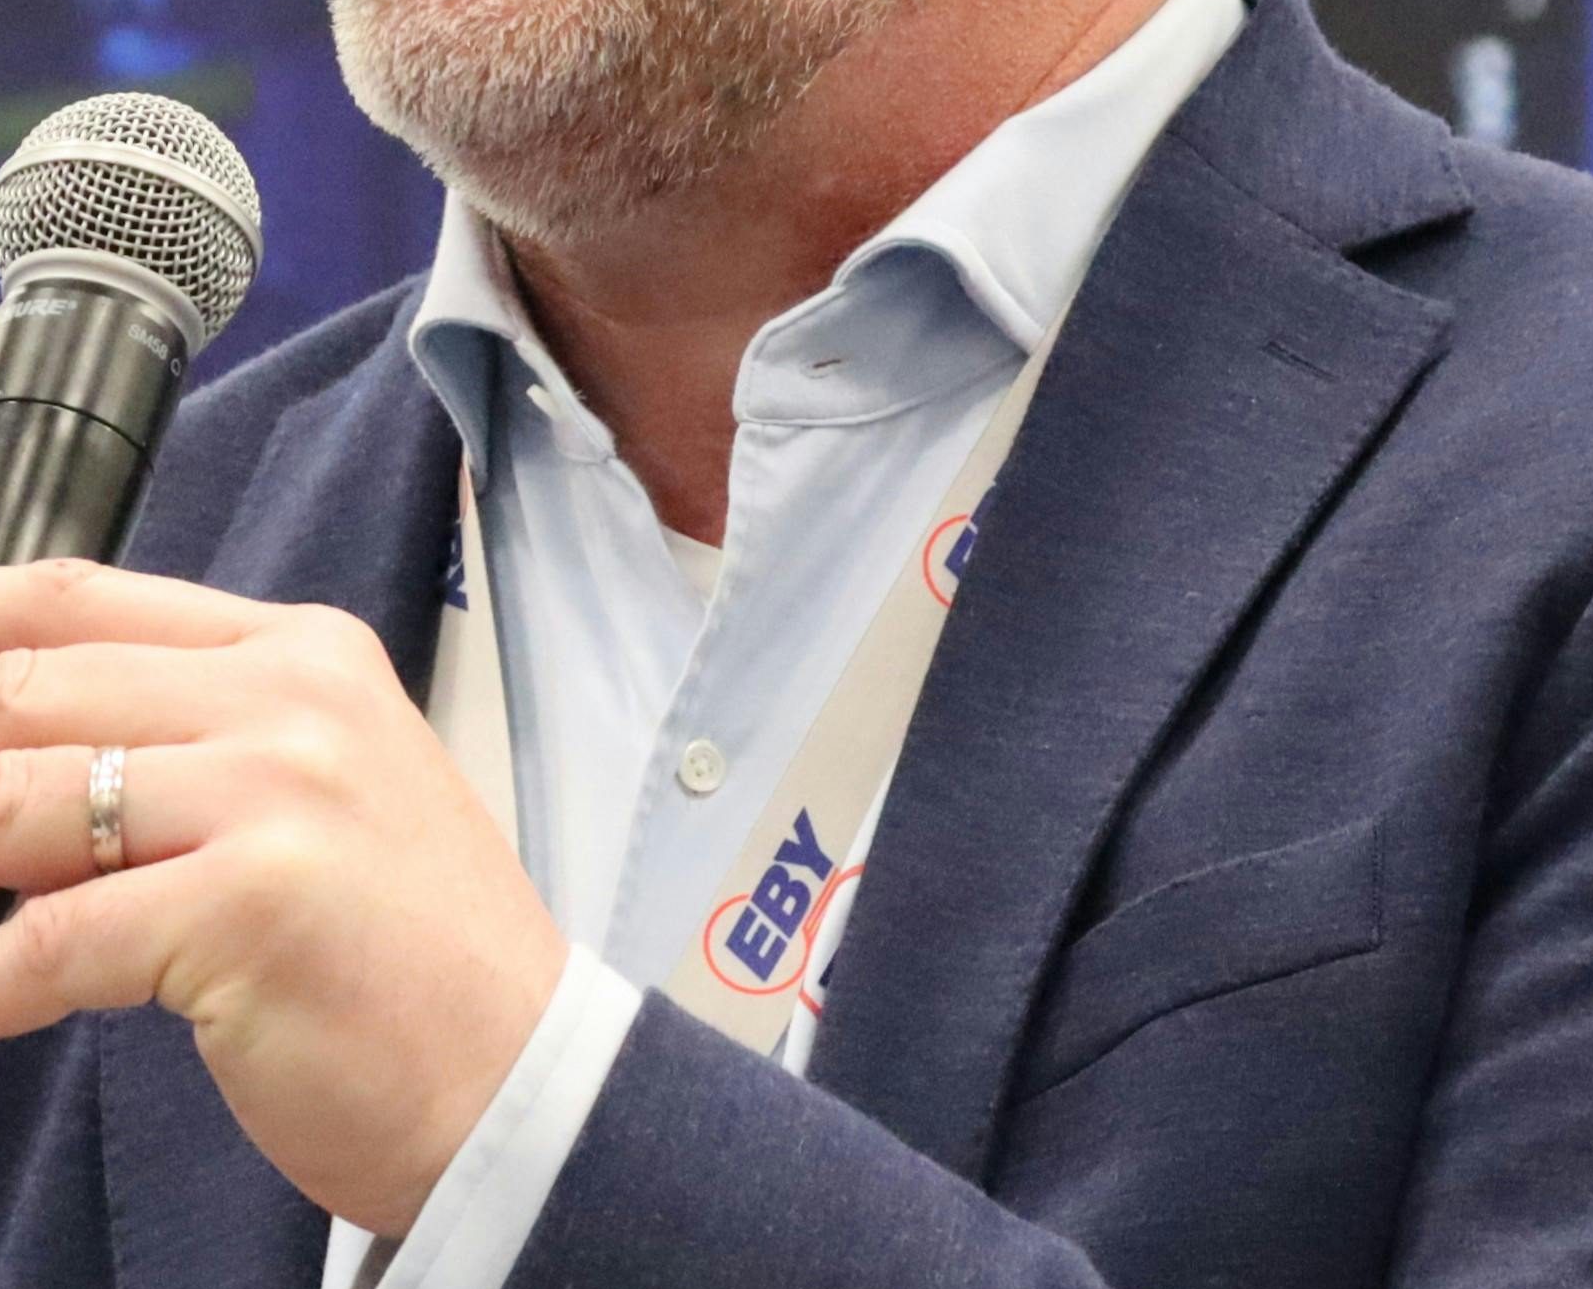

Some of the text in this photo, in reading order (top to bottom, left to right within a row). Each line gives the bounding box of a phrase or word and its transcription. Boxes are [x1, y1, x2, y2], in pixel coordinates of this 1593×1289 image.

[3, 299, 68, 322] URE
[127, 322, 170, 361] SM58
[725, 805, 835, 982] EBY
